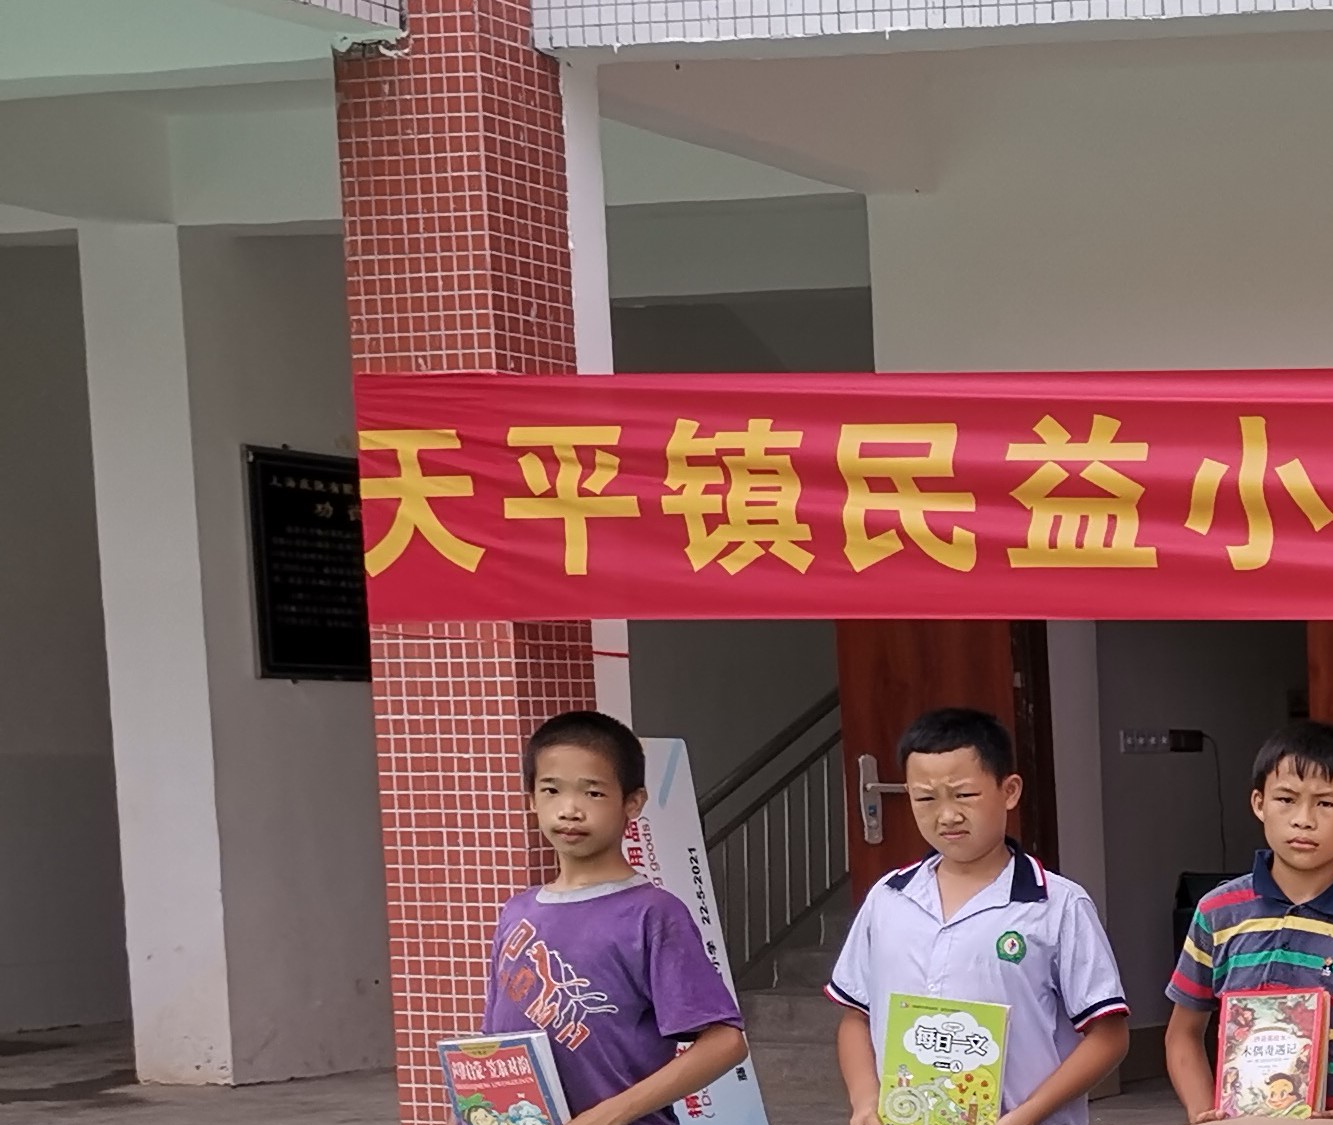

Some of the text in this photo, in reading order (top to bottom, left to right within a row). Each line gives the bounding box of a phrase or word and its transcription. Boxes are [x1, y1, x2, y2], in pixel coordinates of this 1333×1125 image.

[687, 846, 711, 925] 22-5-2021
[915, 1026, 989, 1057] 每日一文
[1241, 1043, 1298, 1058] 木偶奇遇记
